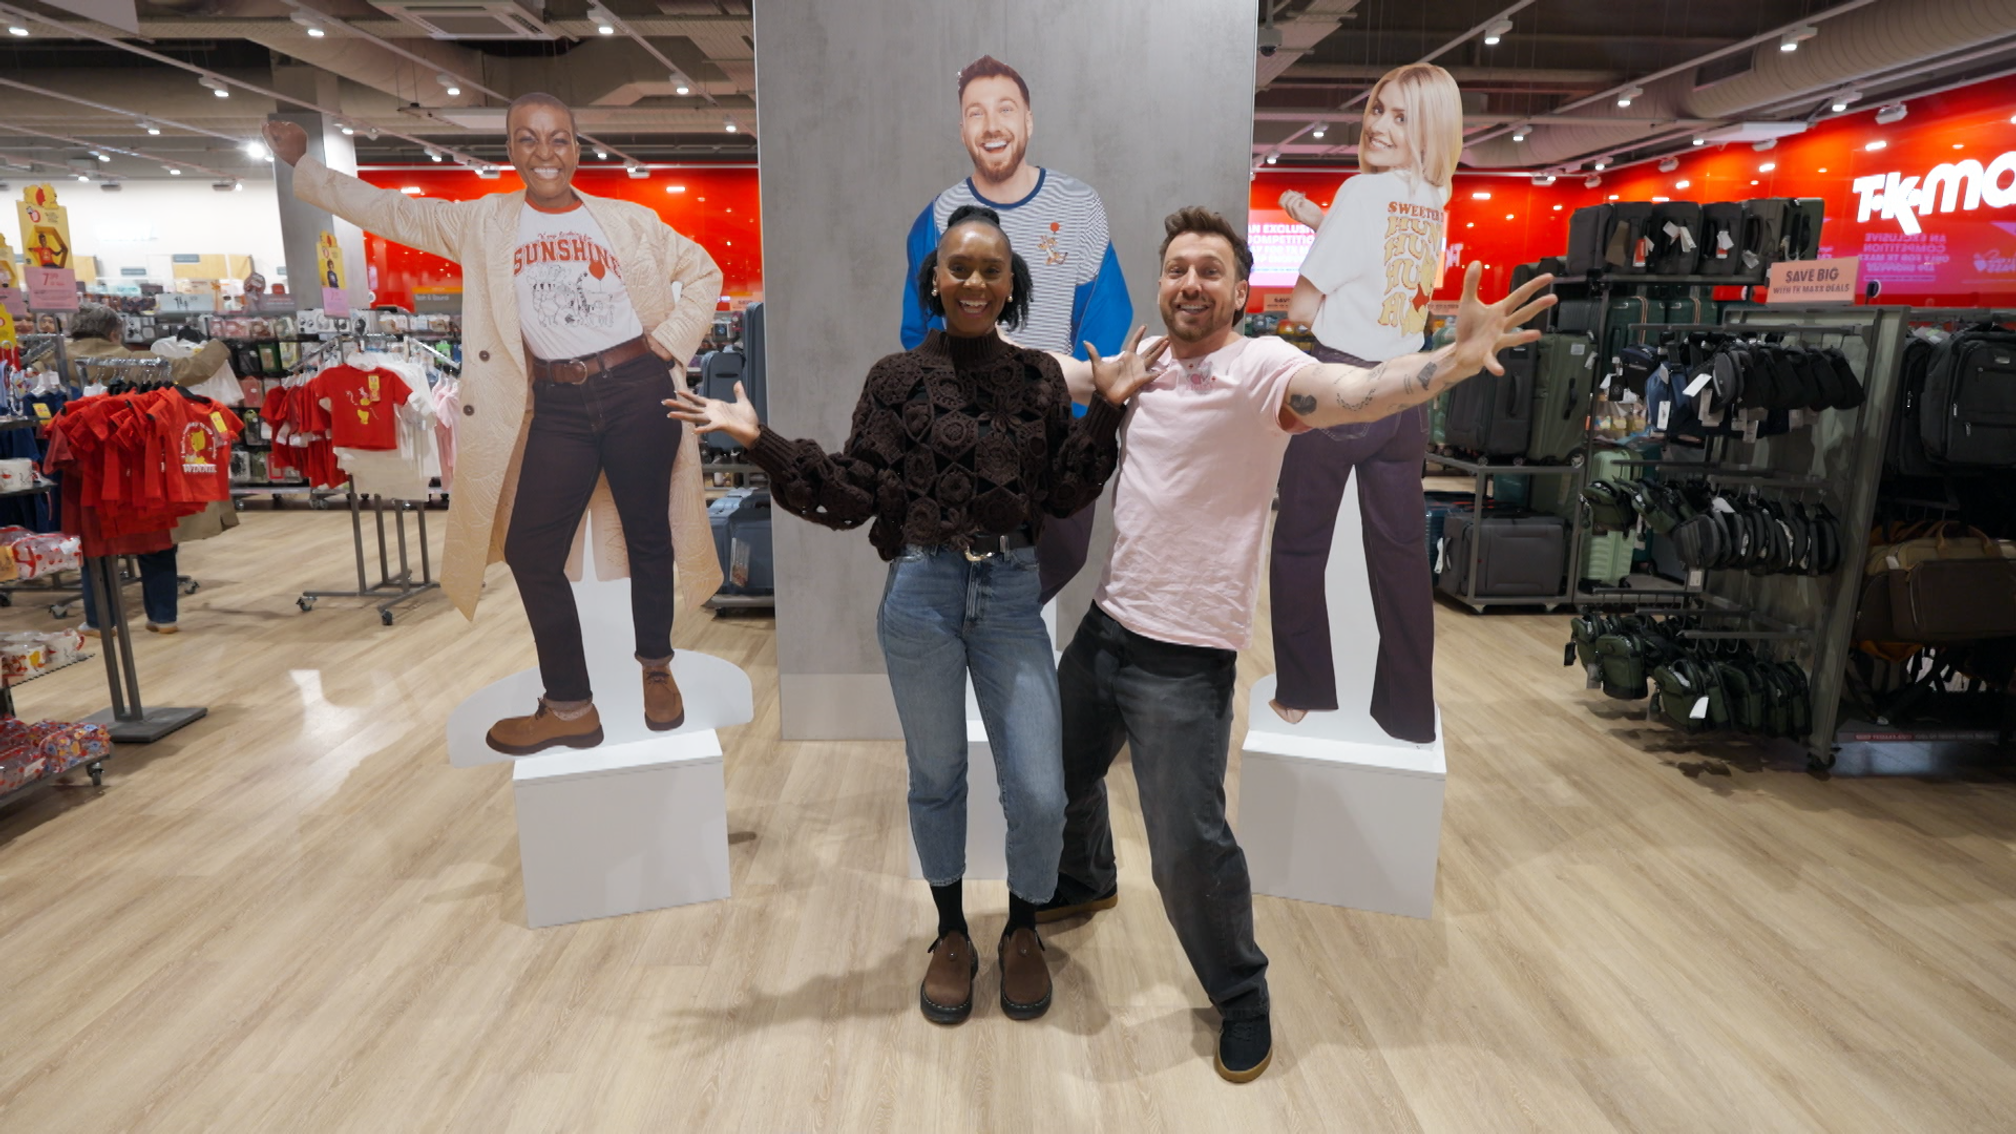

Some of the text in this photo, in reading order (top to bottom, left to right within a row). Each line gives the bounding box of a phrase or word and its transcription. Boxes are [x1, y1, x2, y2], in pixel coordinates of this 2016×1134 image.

[513, 238, 622, 278] SUNSHINE
[1785, 267, 1840, 284] SAVE BIG
[1773, 286, 1792, 295] WITH
[1792, 286, 1802, 294] TK
[1825, 284, 1850, 293] DEALS
